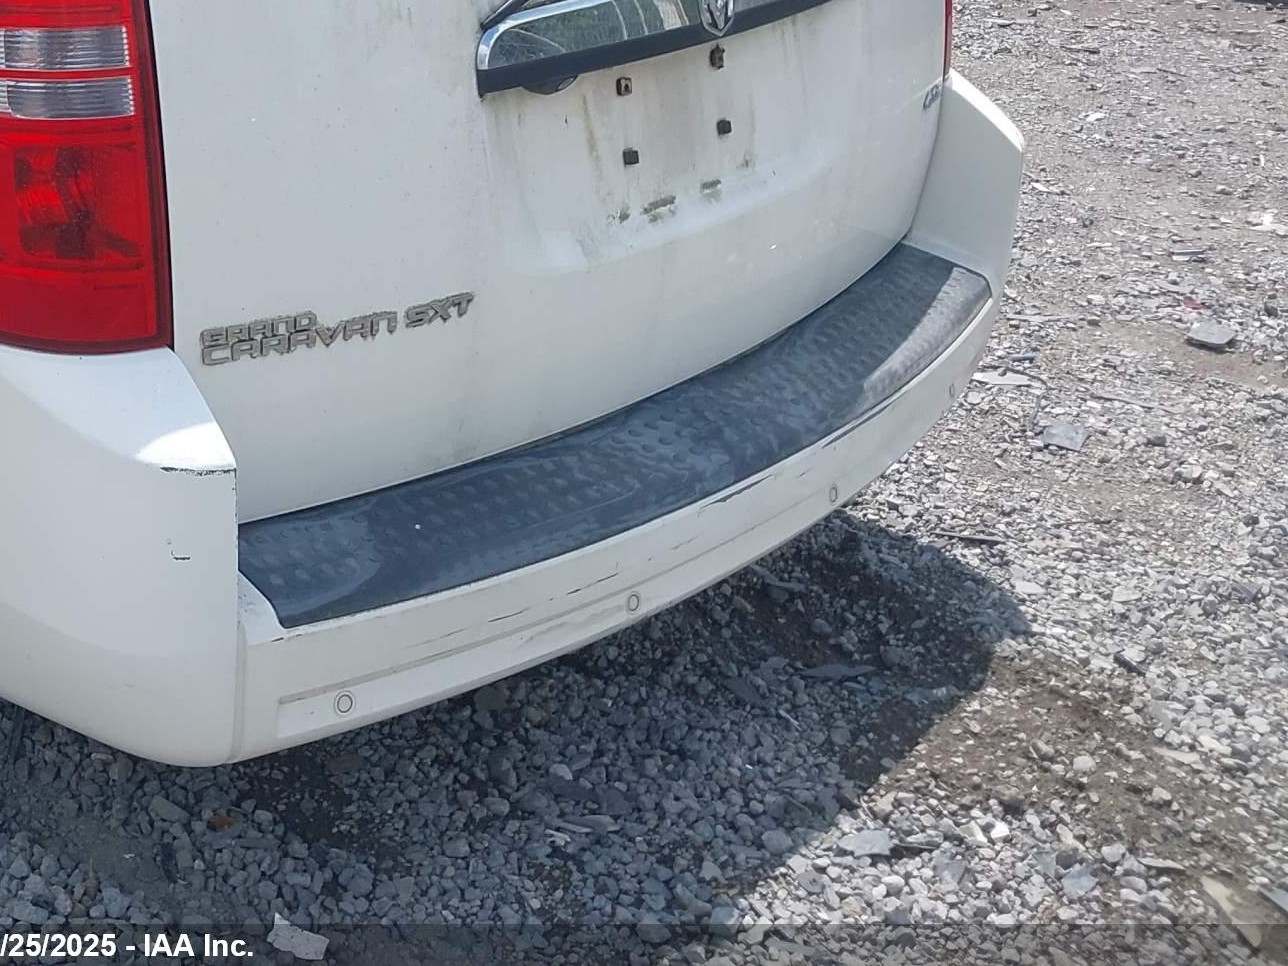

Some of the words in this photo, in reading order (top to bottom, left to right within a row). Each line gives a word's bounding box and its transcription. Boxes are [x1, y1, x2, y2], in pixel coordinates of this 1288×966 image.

[200, 311, 317, 347] GRAND
[201, 311, 398, 366] CARAVAN
[405, 292, 475, 329] SXT
